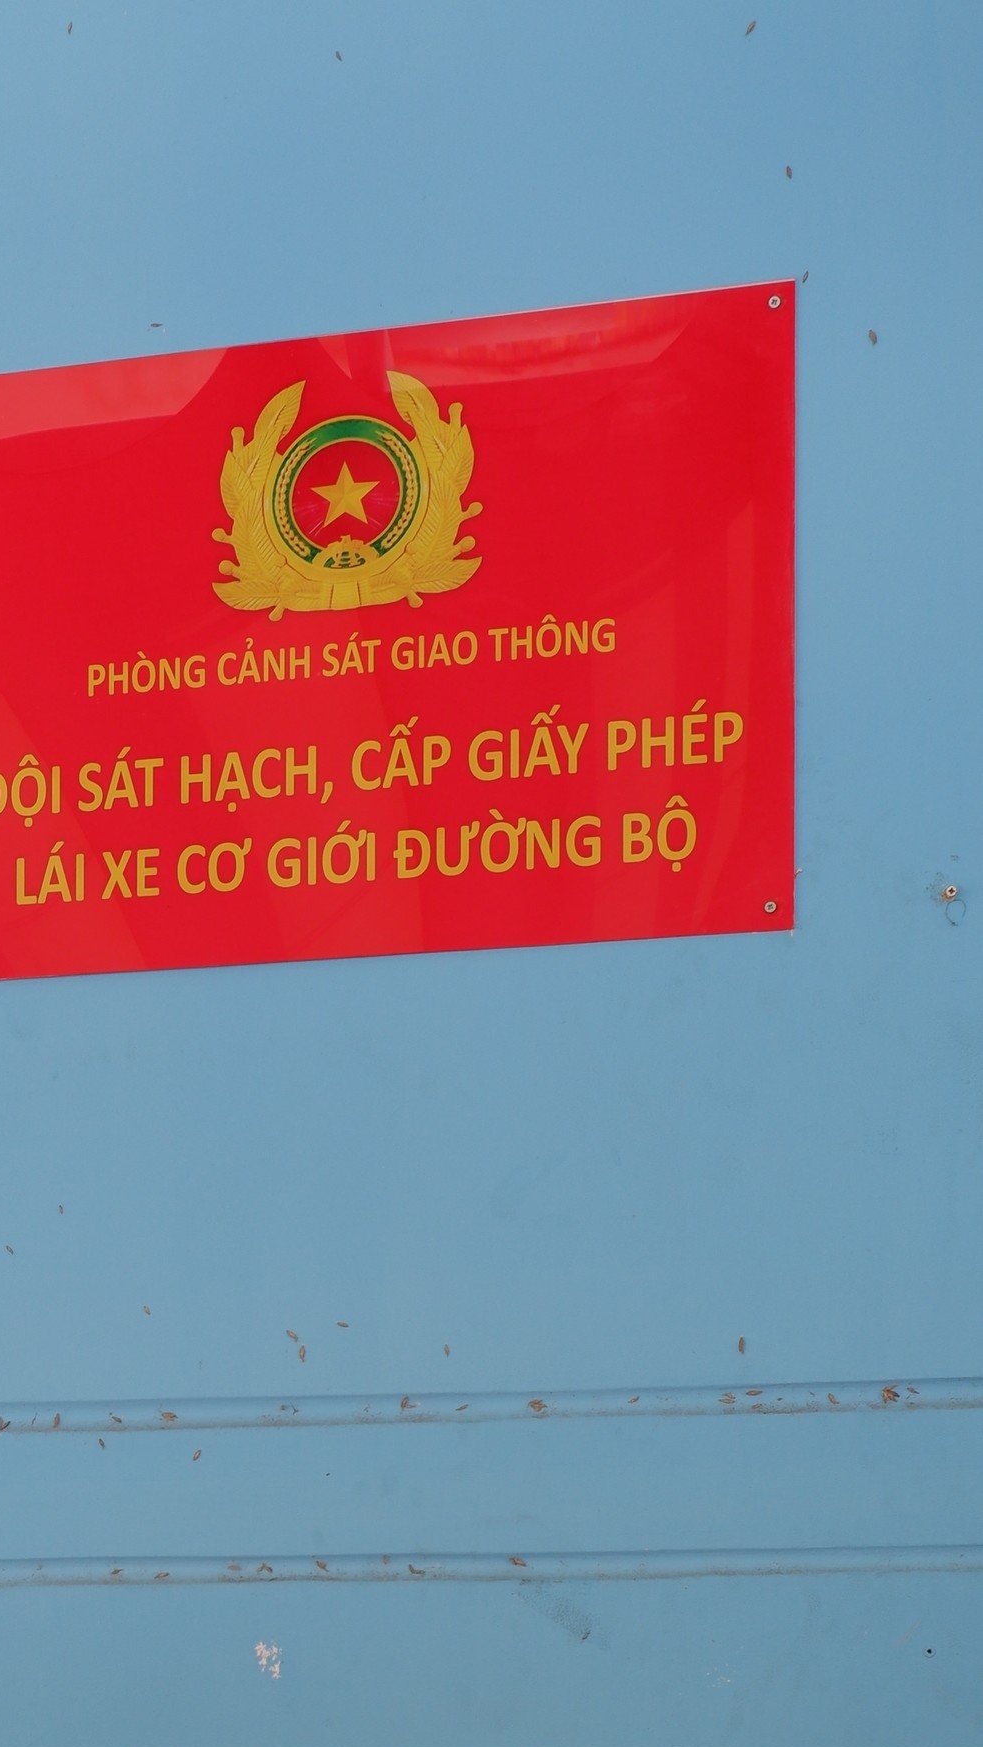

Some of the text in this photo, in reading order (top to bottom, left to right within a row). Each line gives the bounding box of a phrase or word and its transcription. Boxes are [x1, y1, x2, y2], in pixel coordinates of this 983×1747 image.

[88, 615, 617, 698] PHÒNG CẢNH SÁT GIAO THÔNG
[78, 746, 164, 812] SÁT
[180, 744, 334, 813] HẠCH,
[351, 716, 452, 791] CẤP
[468, 704, 589, 781] GIẤY
[607, 700, 744, 771] PHÉP
[14, 795, 697, 906] LÁI XE CƠ GIỚI ĐƯỜNG BỘ
